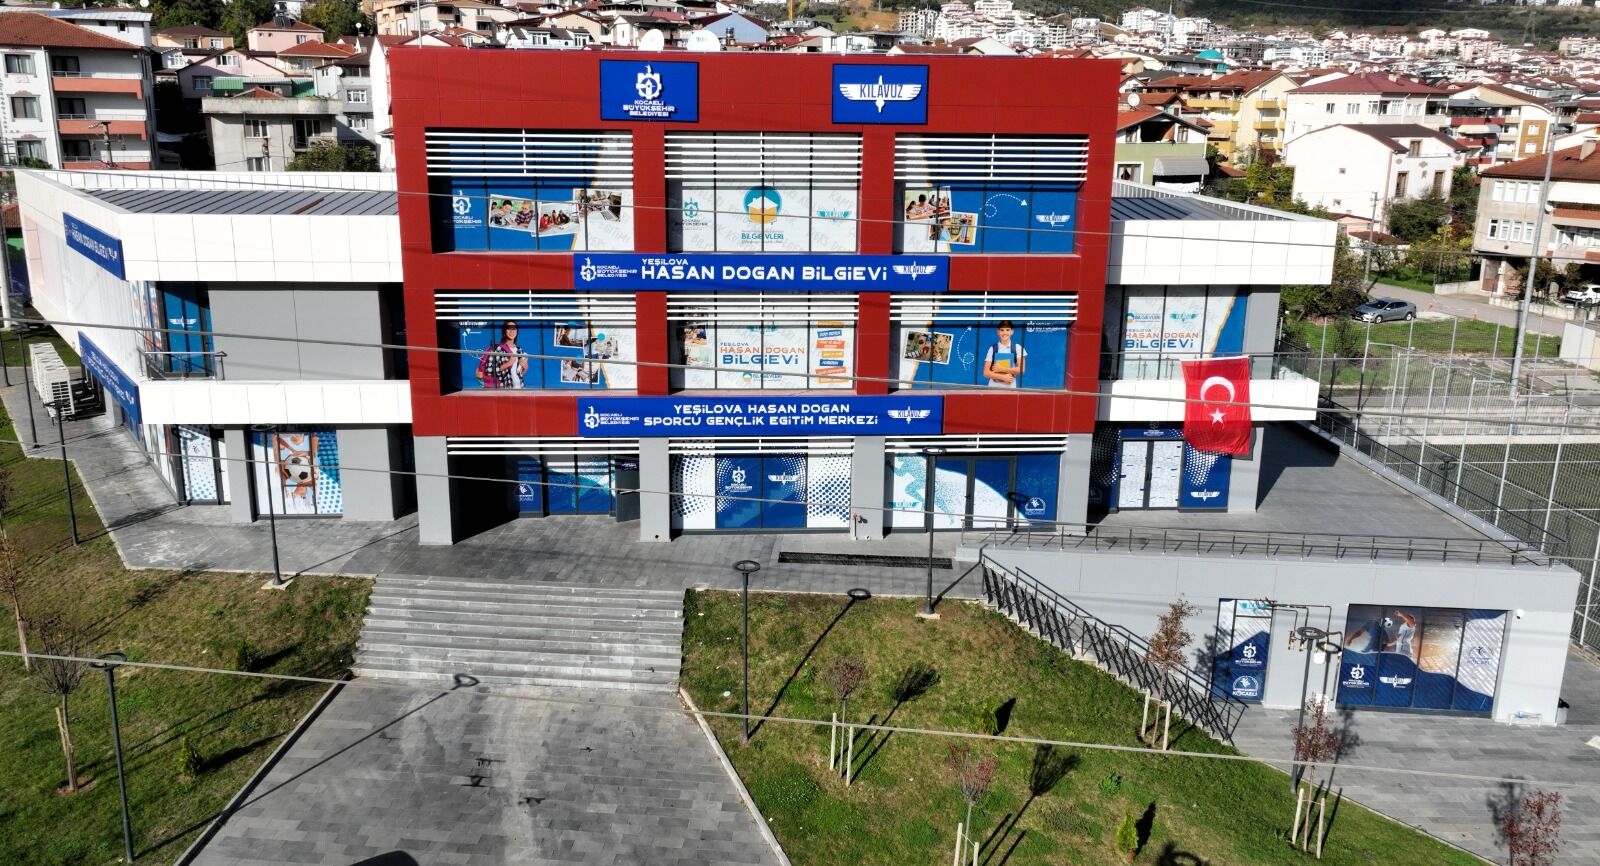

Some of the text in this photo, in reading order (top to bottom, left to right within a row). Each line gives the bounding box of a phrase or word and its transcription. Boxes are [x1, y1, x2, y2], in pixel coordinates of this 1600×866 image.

[860, 84, 903, 98] KILAVUZ
[642, 266, 714, 279] HASAN
[720, 346, 761, 354] HASAN
[749, 405, 796, 413] HASAN
[644, 417, 701, 425] SPORCU
